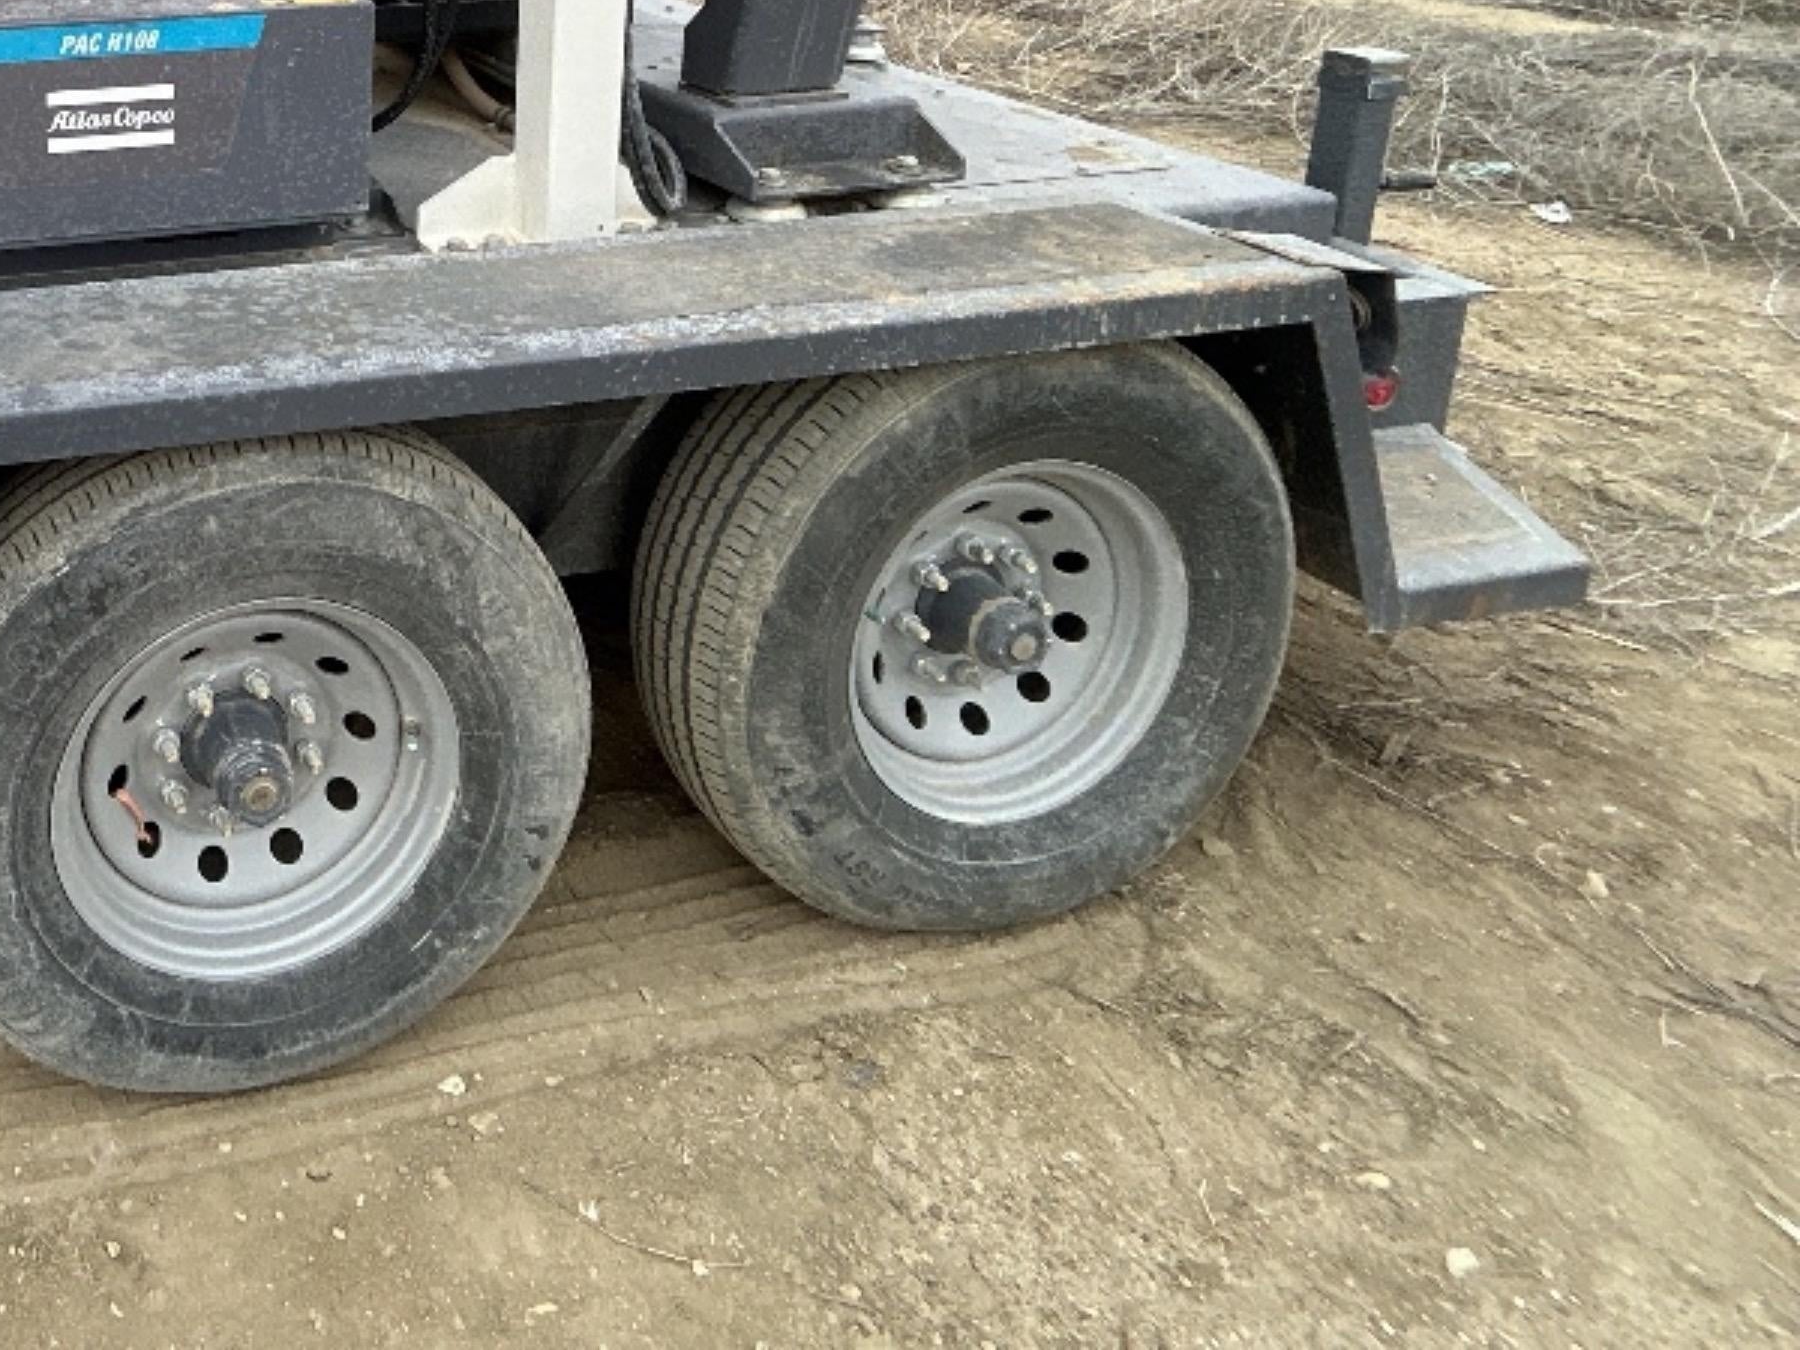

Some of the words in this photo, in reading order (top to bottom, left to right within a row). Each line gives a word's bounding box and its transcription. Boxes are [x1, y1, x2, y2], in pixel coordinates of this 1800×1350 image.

[59, 33, 103, 55] PAC
[106, 29, 161, 53] H108
[48, 110, 112, 132] Atlas
[113, 106, 176, 129] Copco
